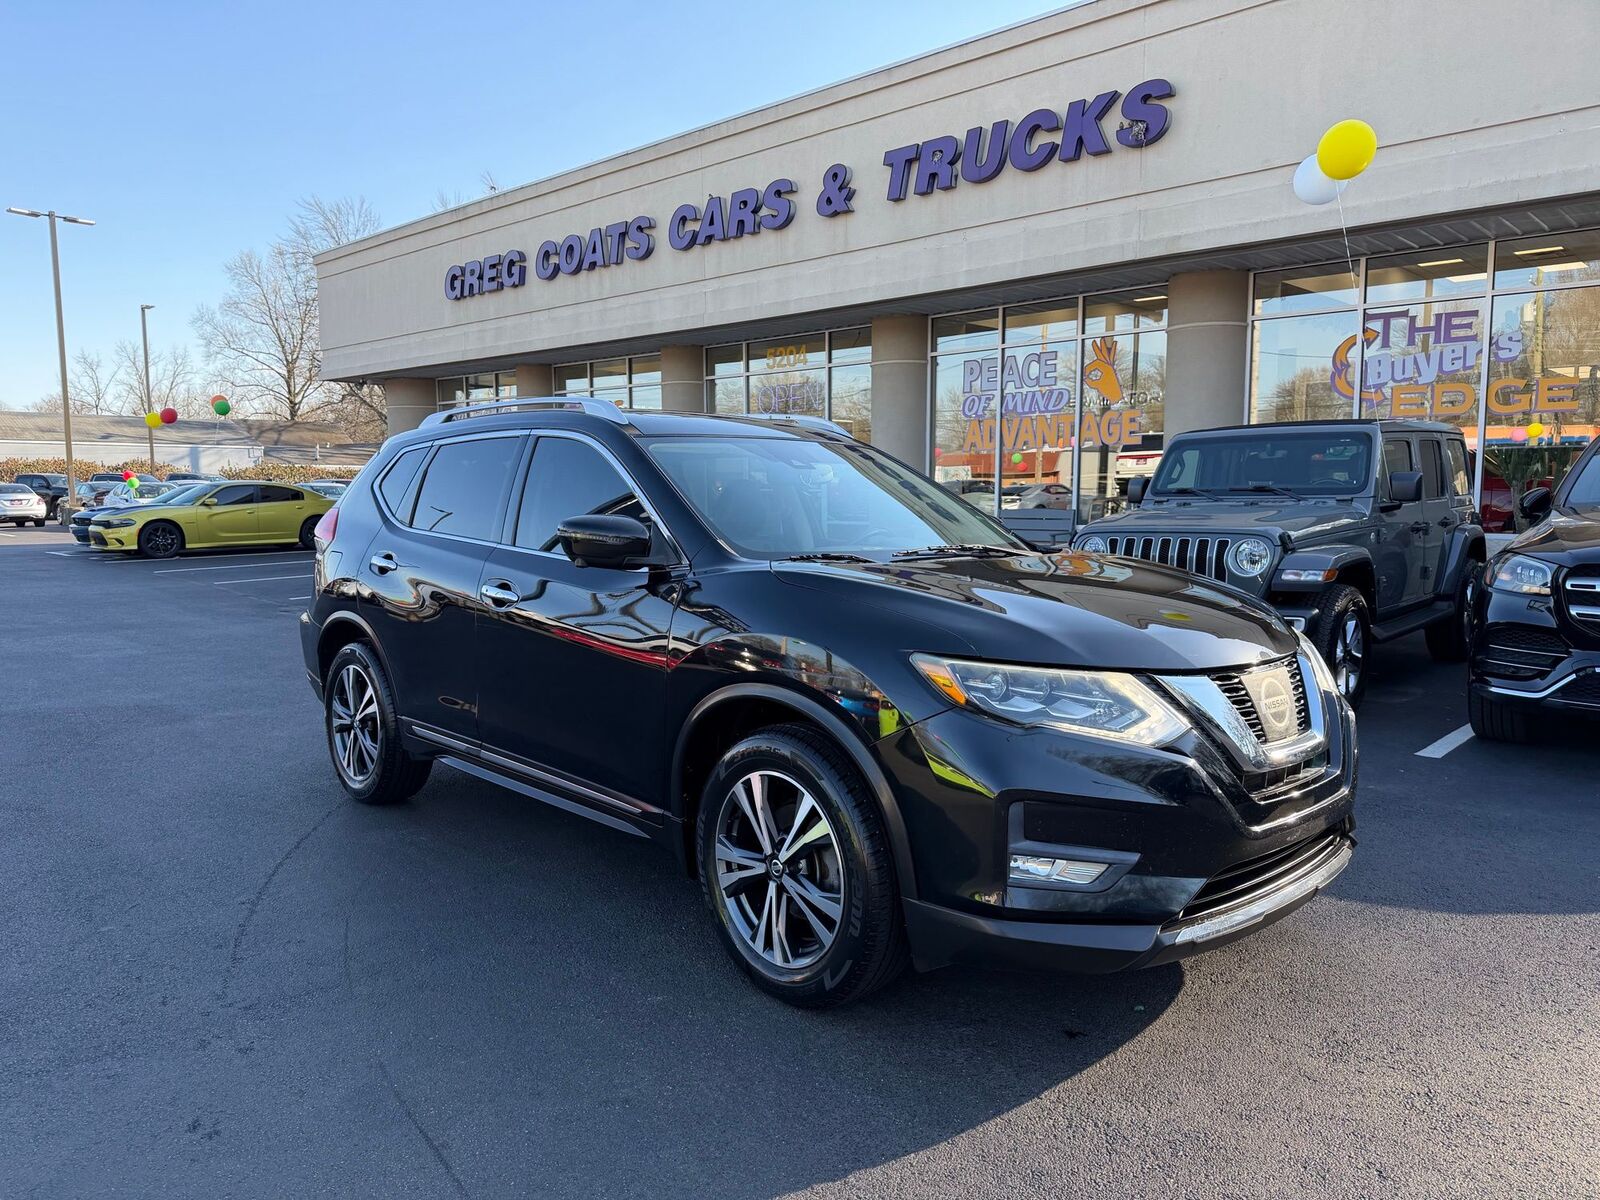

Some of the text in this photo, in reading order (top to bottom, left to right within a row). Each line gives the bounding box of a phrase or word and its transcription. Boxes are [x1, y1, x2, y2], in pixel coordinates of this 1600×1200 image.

[444, 78, 1176, 301] GREG COATS CARS & TRUCKS
[1364, 308, 1479, 348] THE
[766, 344, 809, 369] 5204
[962, 351, 1058, 394] PEACE
[758, 381, 821, 414] OPEN
[962, 387, 1070, 419] OF MIND
[1390, 375, 1580, 418] EDGE
[962, 409, 1142, 453] ADVANTAGE
[1264, 698, 1289, 710] NISSAN
